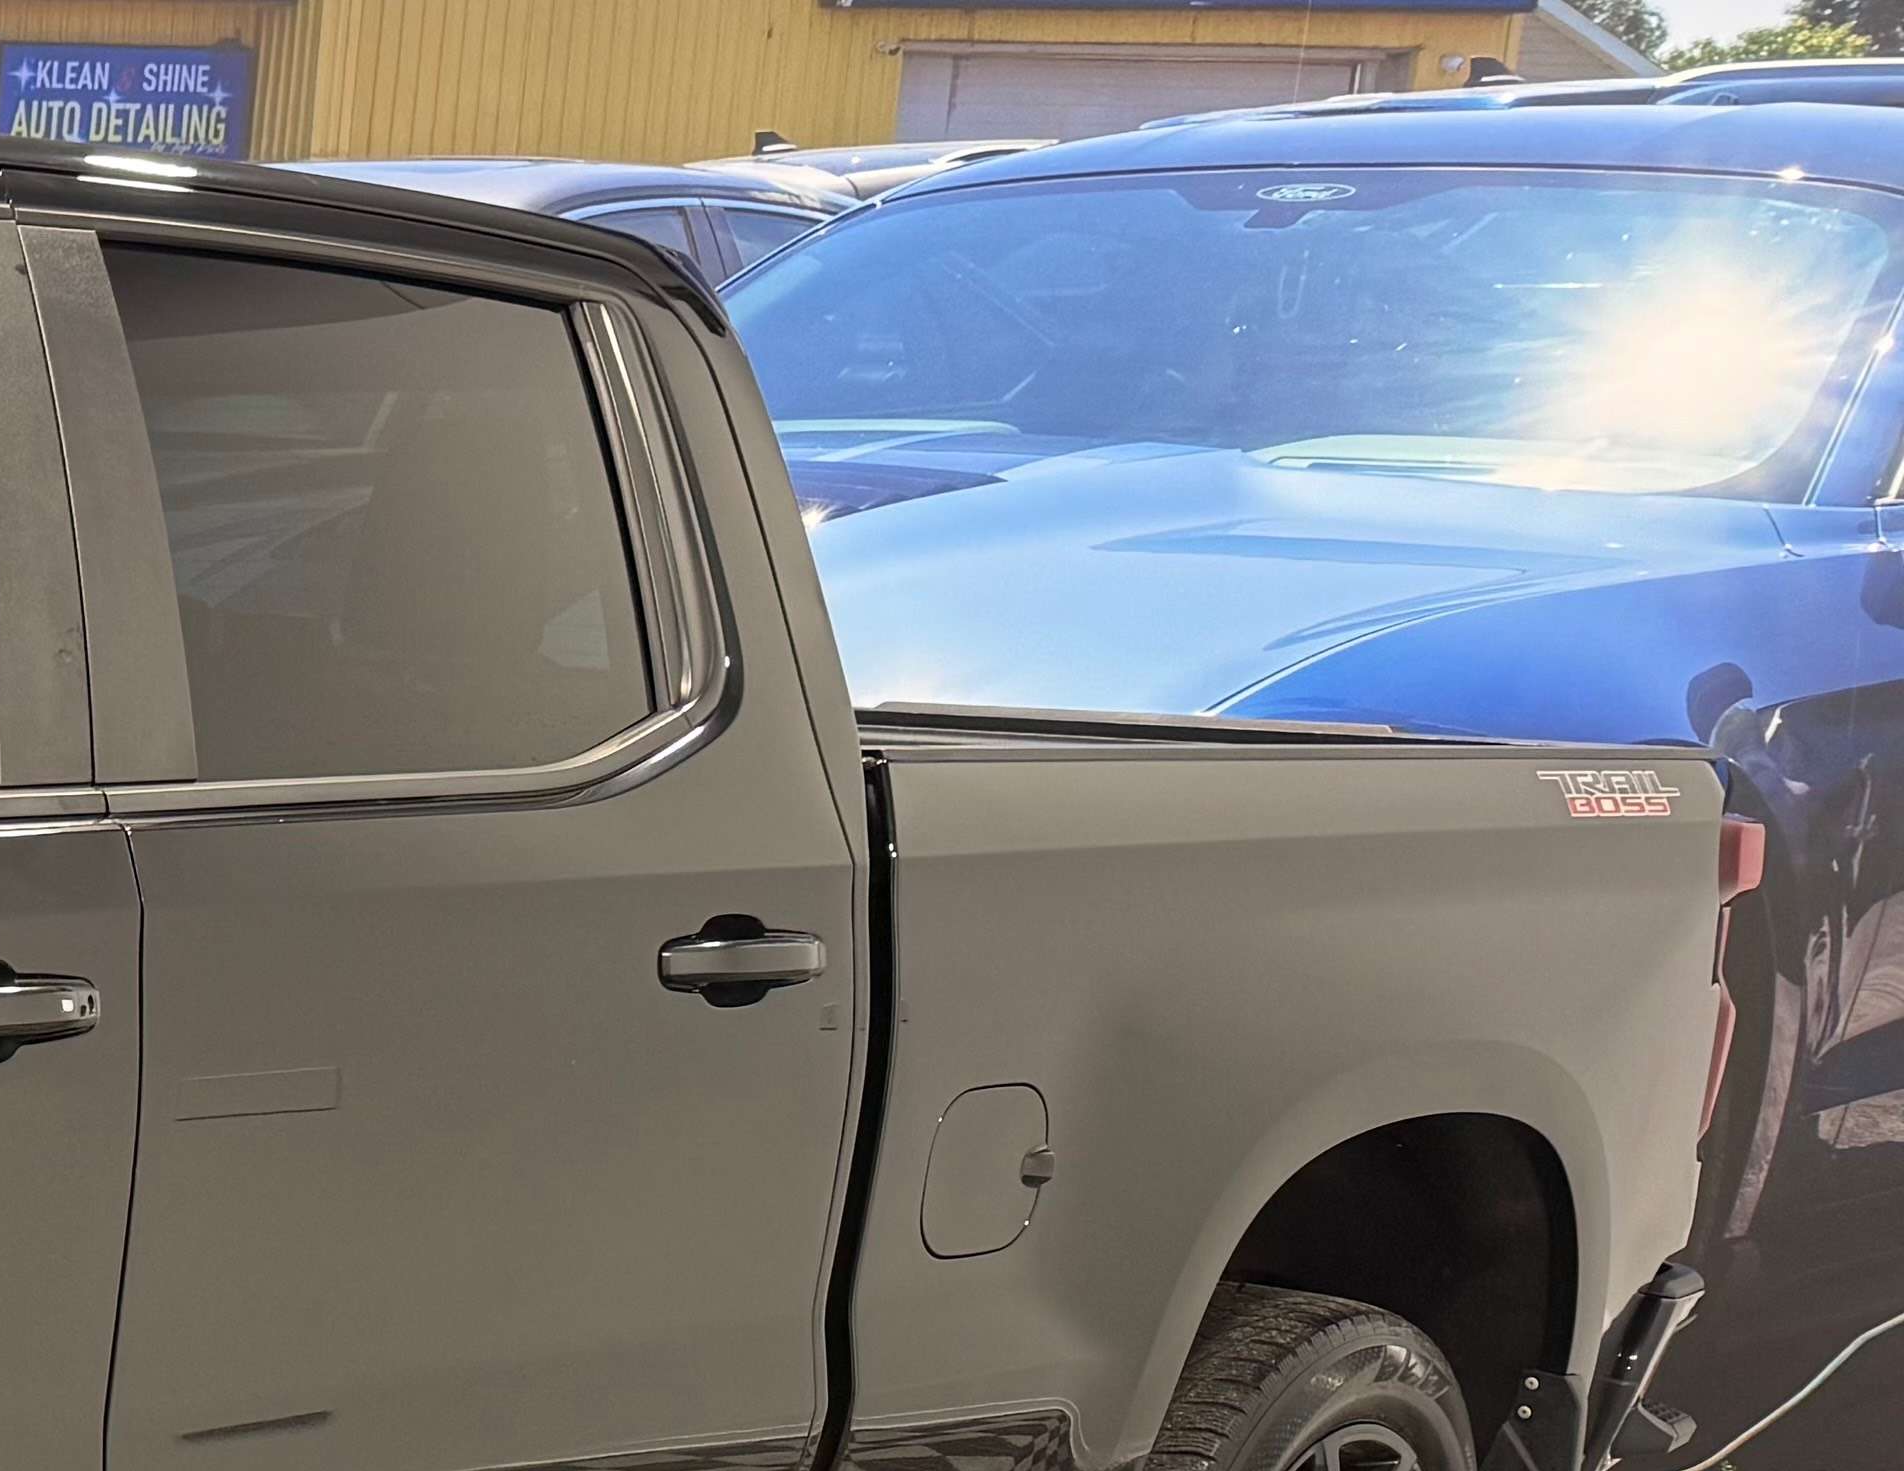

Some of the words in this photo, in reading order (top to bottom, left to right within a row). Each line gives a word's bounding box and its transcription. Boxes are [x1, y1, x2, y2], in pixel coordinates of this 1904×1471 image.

[36, 61, 109, 91] KLEAN
[143, 64, 210, 93] SHINE
[10, 99, 81, 140] AUTO
[89, 102, 226, 145] DETAILING
[1536, 770, 1680, 797] TRAIL
[1566, 795, 1671, 818] BOSS
